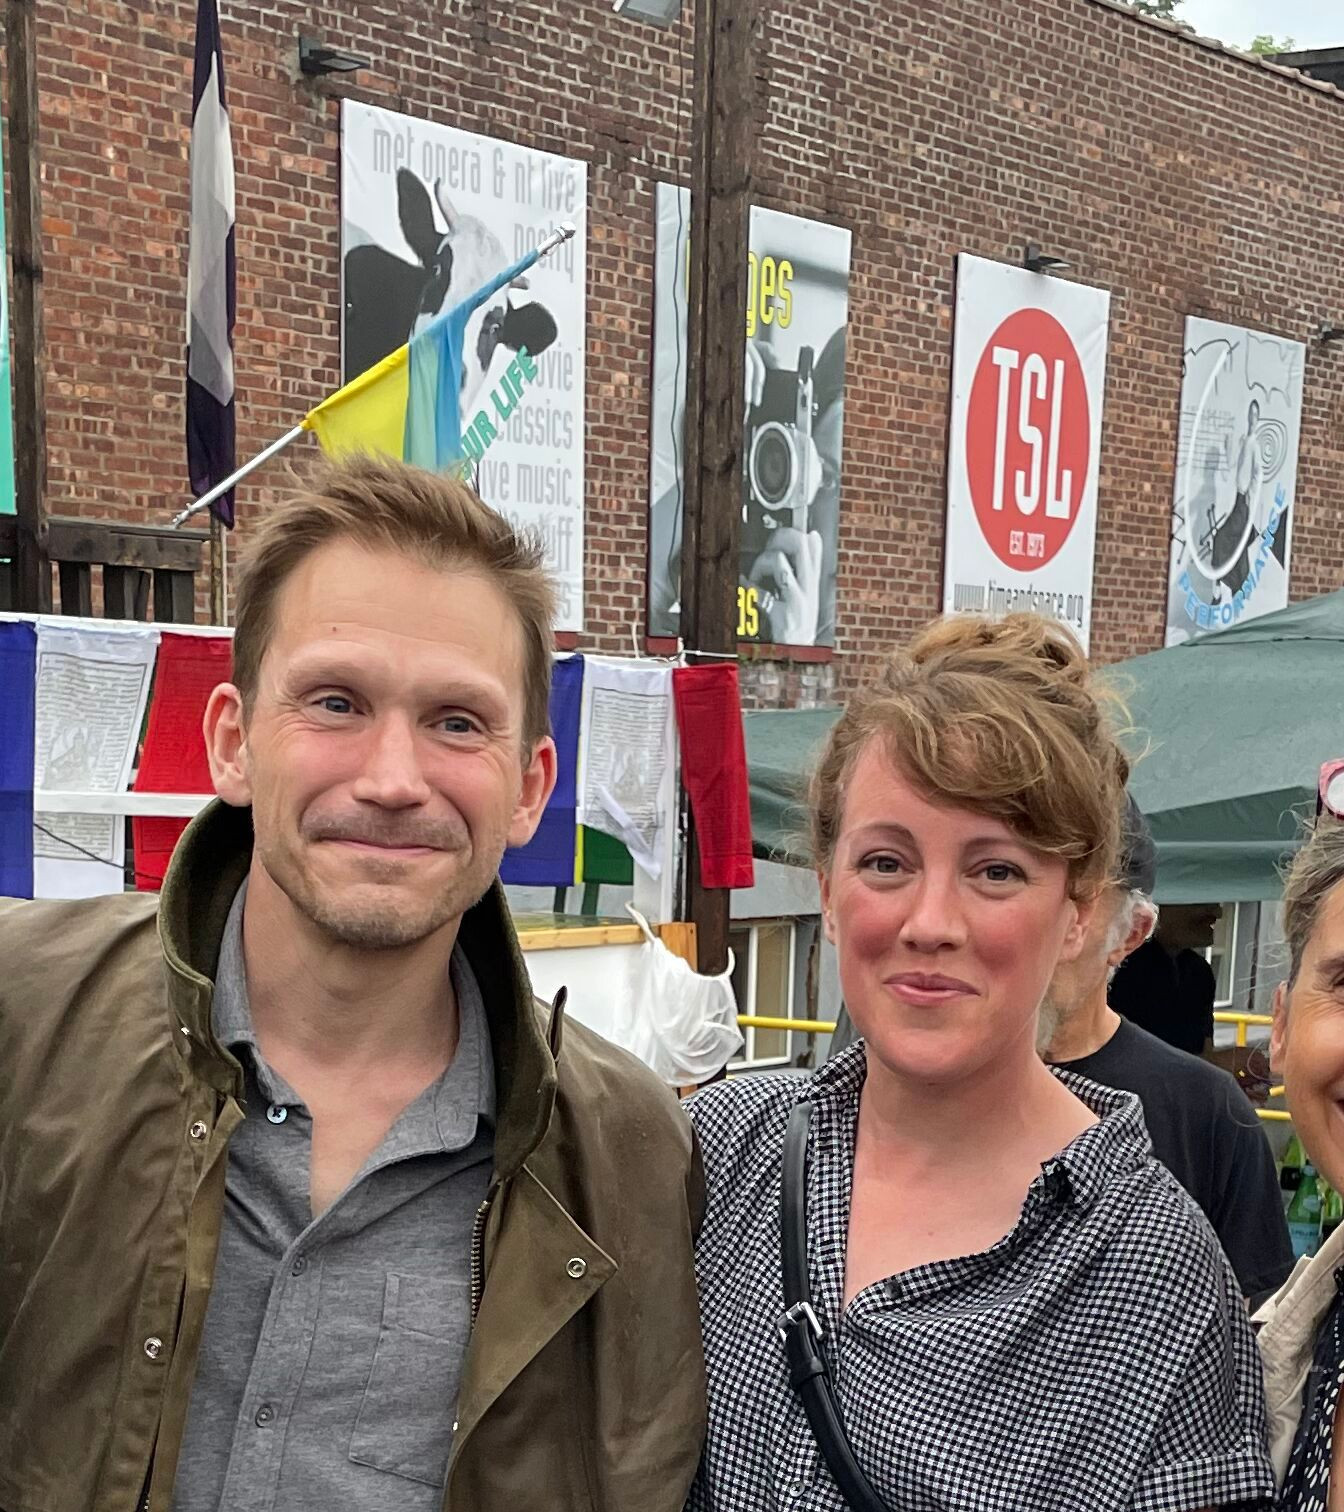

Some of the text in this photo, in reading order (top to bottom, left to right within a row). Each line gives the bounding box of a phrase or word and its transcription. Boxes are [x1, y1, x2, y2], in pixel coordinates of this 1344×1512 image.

[373, 126, 577, 214] met opera & nt live
[490, 344, 539, 422] LIFE
[524, 341, 573, 392] ovie
[992, 345, 1073, 520] TSL
[481, 458, 573, 507] ive music
